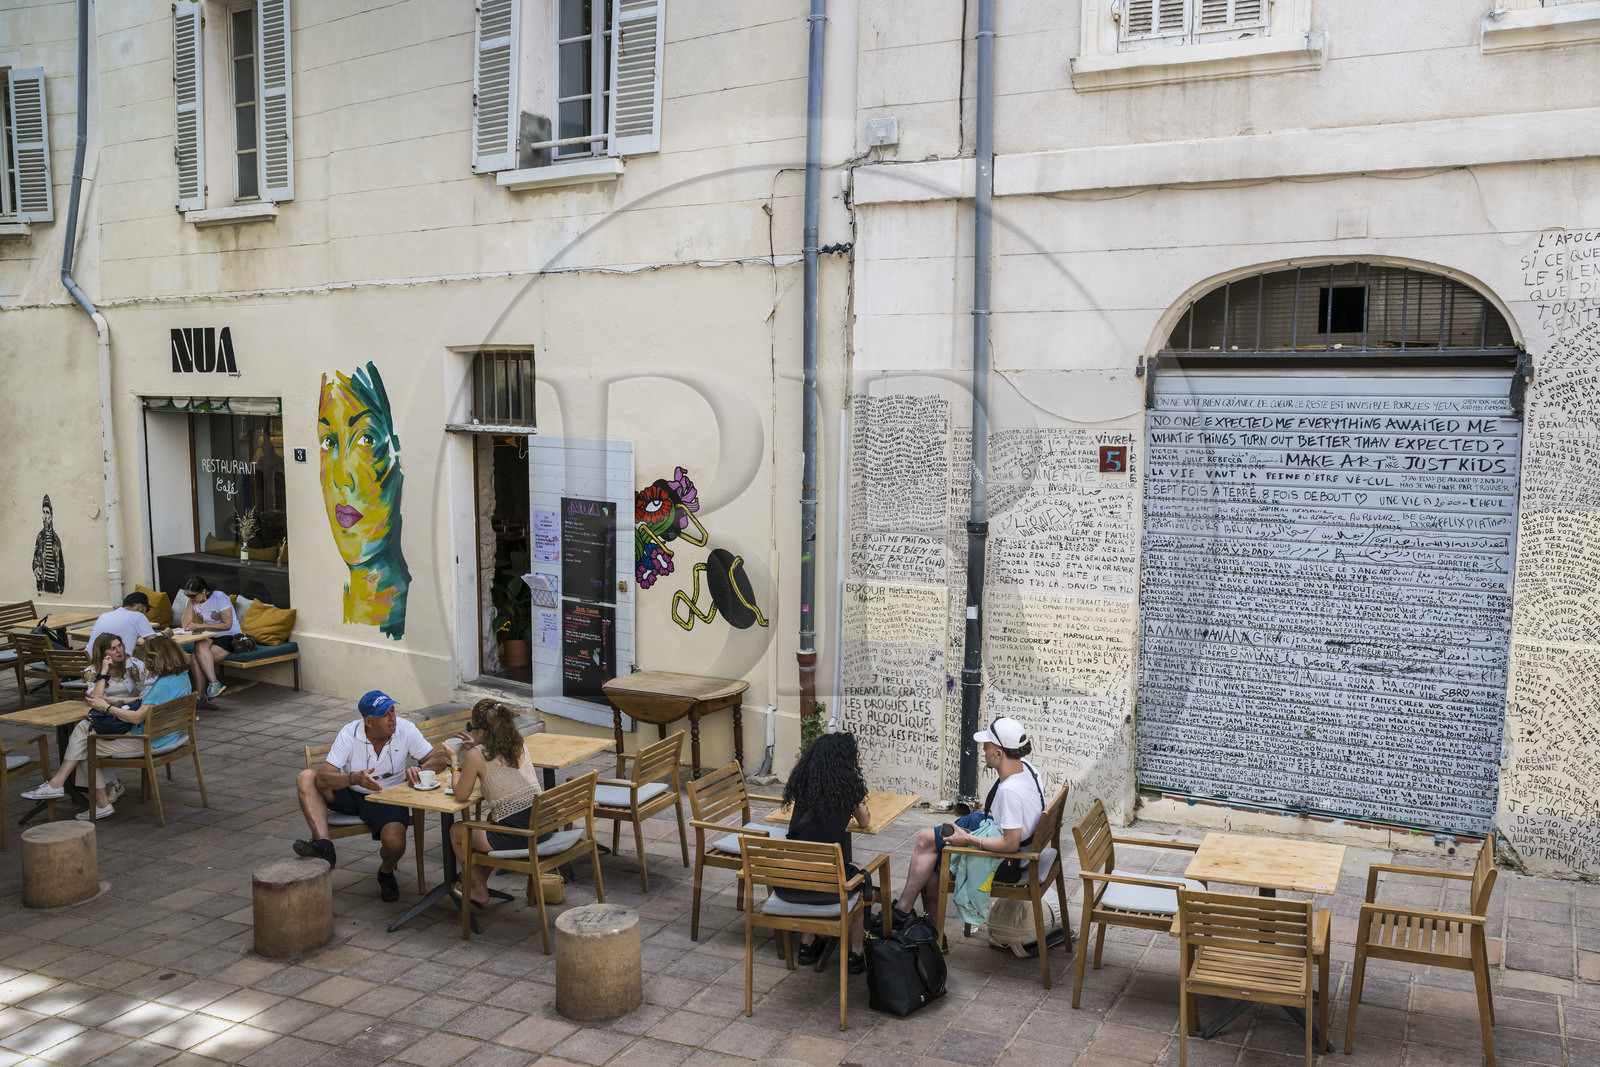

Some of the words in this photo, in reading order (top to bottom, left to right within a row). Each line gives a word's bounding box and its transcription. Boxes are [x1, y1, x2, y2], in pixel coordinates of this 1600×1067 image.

[1545, 253, 1564, 267] CE
[1571, 248, 1600, 262] QUE
[1524, 271, 1548, 286] LE
[1530, 286, 1567, 301] QUE
[1564, 322, 1598, 349] SOMMES
[171, 327, 237, 372] NUA
[1532, 376, 1559, 390] TANT
[1566, 369, 1590, 379] QUE
[1548, 376, 1598, 393] MONSIEUR
[1169, 398, 1180, 407] NE
[1202, 398, 1220, 407] BIEN
[1257, 398, 1268, 408] LE
[1270, 399, 1293, 408] COEUR
[1305, 400, 1329, 410] RESTE
[1331, 400, 1345, 409] EST
[1393, 401, 1412, 410] POUR
[1412, 401, 1430, 411] LES
[1433, 401, 1460, 412] YEUX
[1153, 416, 1170, 426] NO
[1174, 416, 1200, 426] ONE
[1204, 417, 1273, 428] EXPECTED
[1275, 417, 1295, 429] ME
[1467, 420, 1498, 433] ME
[1151, 432, 1182, 443] WHAT
[1239, 434, 1267, 445] TURN
[1270, 435, 1293, 447] OUT
[1298, 436, 1351, 448] BETTER
[1353, 436, 1390, 449] THAN
[298, 450, 302, 460] 3
[1106, 451, 1121, 471] 5
[1207, 456, 1243, 464] REBECCA
[202, 459, 257, 474] RESTAURANT
[1285, 453, 1335, 467] MAKE
[1339, 454, 1386, 471] ART
[1385, 461, 1400, 469] ARE
[1402, 456, 1457, 471] JUST
[1170, 469, 1194, 478] VIE
[1206, 470, 1236, 478] VAUT
[1243, 471, 1257, 479] LA
[1266, 472, 1299, 480] PEINE
[216, 477, 238, 500] Café
[1153, 484, 1177, 495] SEPT
[1262, 490, 1269, 499] 8
[1304, 490, 1352, 502] DEBOUT
[1379, 495, 1398, 506] UNE
[1523, 493, 1536, 501] NO
[1521, 507, 1549, 520] QUAND
[1523, 521, 1554, 531] RESPECT
[1577, 526, 1598, 536] VOTRE
[851, 534, 860, 543] LE
[888, 535, 899, 543] NE
[919, 536, 930, 544] PAS
[873, 553, 885, 562] DE
[1241, 558, 1271, 567] AMOUR
[1274, 559, 1292, 569] PAIX
[1300, 564, 1334, 573] JUSTICE
[1062, 571, 1088, 579] MAITE
[1174, 572, 1223, 581] MARSEILLE
[1227, 576, 1248, 584] AVEC
[1332, 584, 1372, 594] PARTOUT
[1208, 592, 1237, 600] SESSION
[1532, 592, 1559, 607] PENSE
[1355, 610, 1400, 618] ABDENOUR
[1545, 608, 1578, 620] PRENDS
[1580, 613, 1595, 626] FEU
[990, 635, 1018, 643] NOSTRO
[1063, 632, 1104, 641] MARSIGLIA
[1515, 644, 1542, 653] FREED
[1546, 647, 1569, 656] FROM
[1006, 656, 1034, 664] MAMAN
[883, 686, 896, 696] LES
[899, 686, 943, 699] CRASSEUX
[1402, 681, 1437, 691] COPINE
[845, 698, 861, 709] LES
[914, 700, 931, 715] LES
[1370, 696, 1397, 705] FAITES
[1445, 705, 1475, 713] CHIENS
[845, 710, 863, 722] LES
[1407, 707, 1447, 717] AILLEURS
[842, 721, 857, 734] LES
[892, 730, 906, 741] LES
[1428, 721, 1459, 731] DEDANS
[1348, 731, 1373, 740] INFINI
[1375, 734, 1398, 742] COME
[1517, 754, 1560, 763] WEEKEND
[1516, 763, 1558, 772] PERSONNE
[1387, 772, 1410, 780] AVANT
[1387, 779, 1418, 788] VOTRE
[1446, 786, 1487, 798] TROUVER
[1417, 792, 1434, 800] BIEN
[1380, 805, 1430, 817] HIBERNATION
[1517, 845, 1544, 856] TOUT
